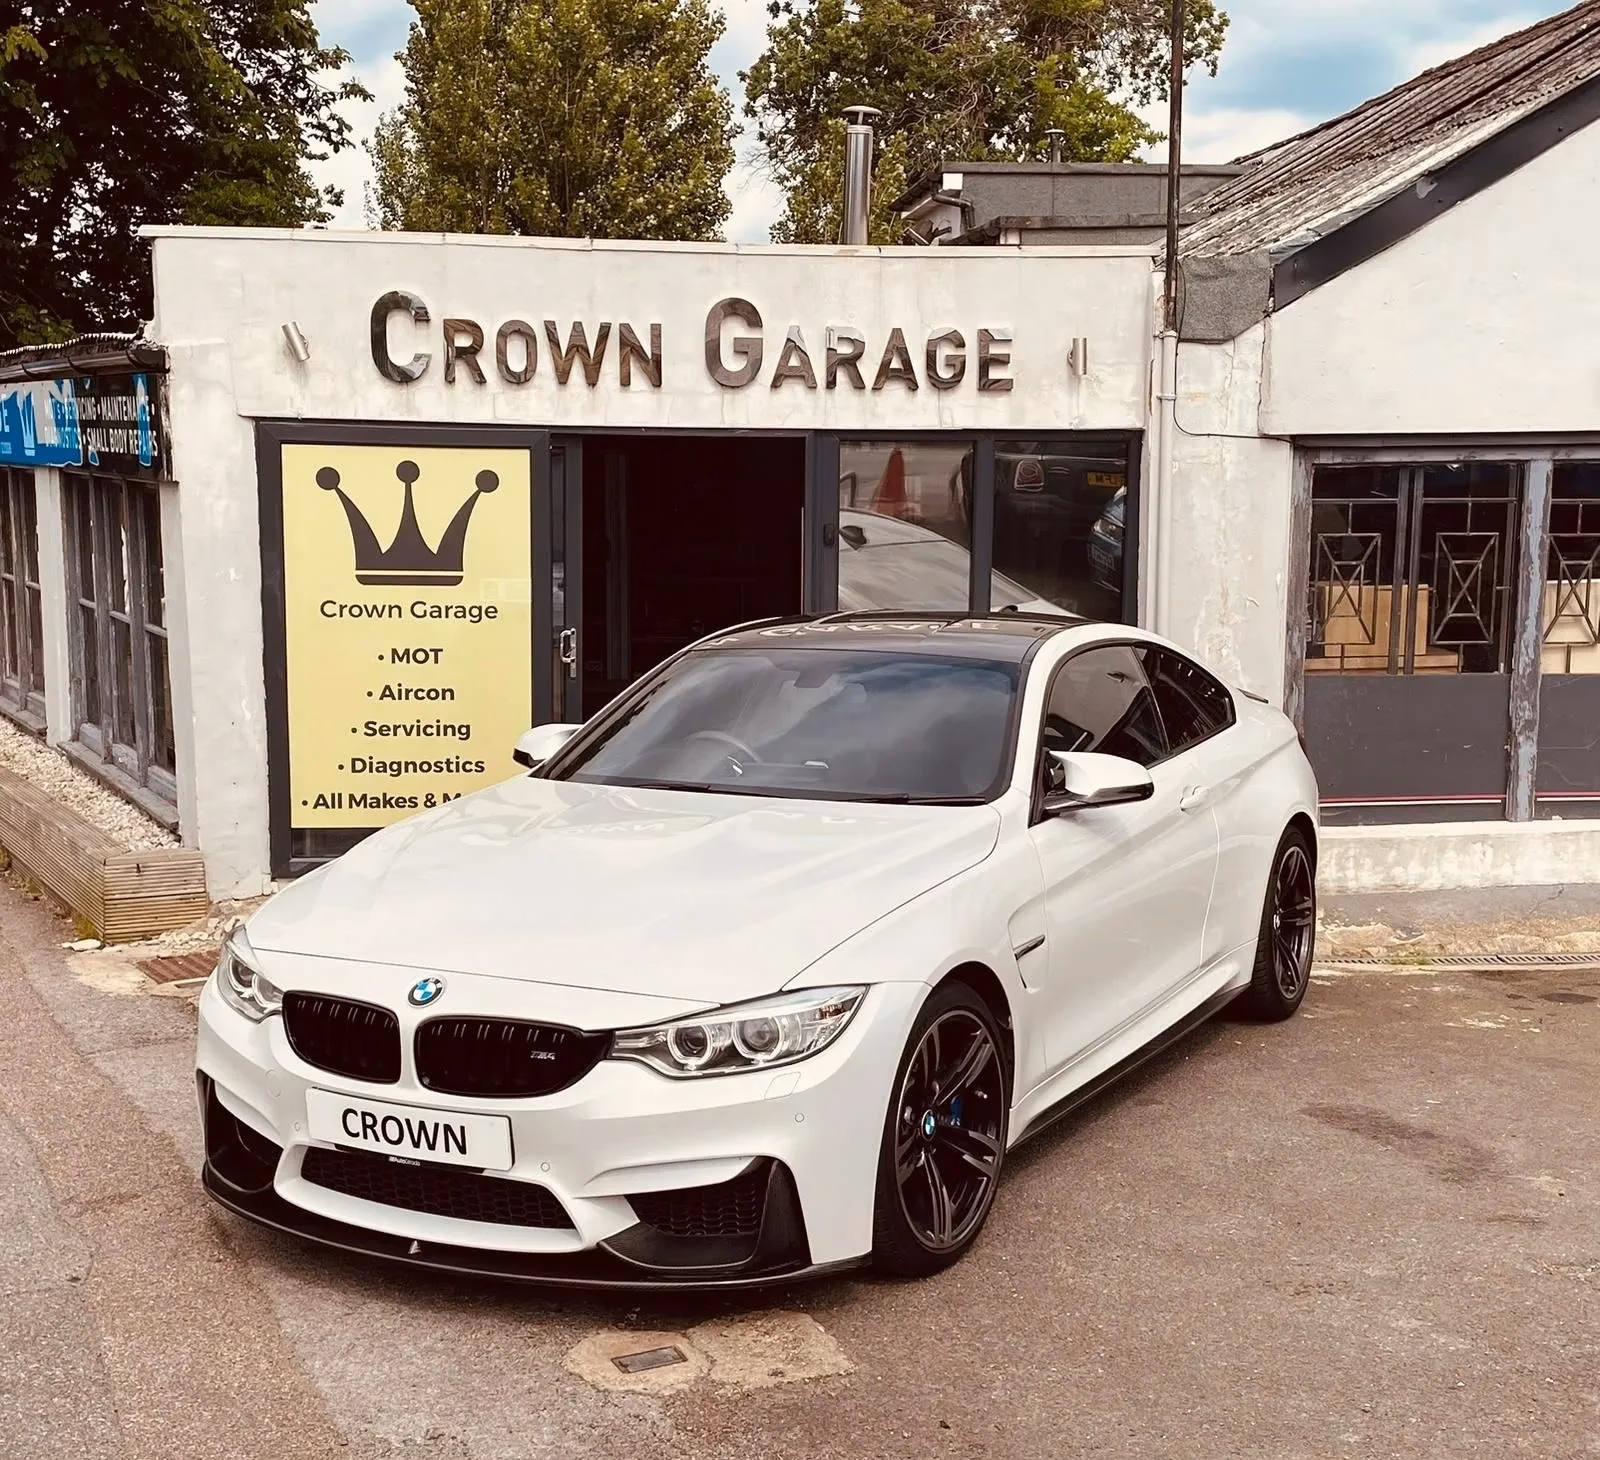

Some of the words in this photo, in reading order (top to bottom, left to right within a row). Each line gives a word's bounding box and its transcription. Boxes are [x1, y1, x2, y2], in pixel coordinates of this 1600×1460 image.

[370, 290, 663, 388] CROWN
[704, 297, 1014, 392] GARAGE
[86, 427, 109, 453] SMALL
[109, 428, 128, 454] BODY
[320, 600, 403, 619] Crown
[409, 601, 499, 624] Garage
[390, 648, 444, 665] MOT
[378, 683, 456, 701] Aircon
[363, 719, 472, 741] Servicing
[350, 756, 486, 778] Diagnostics
[312, 792, 343, 810] All
[348, 792, 419, 809] Makes
[423, 792, 438, 809] &
[341, 1107, 468, 1156] CROWN
